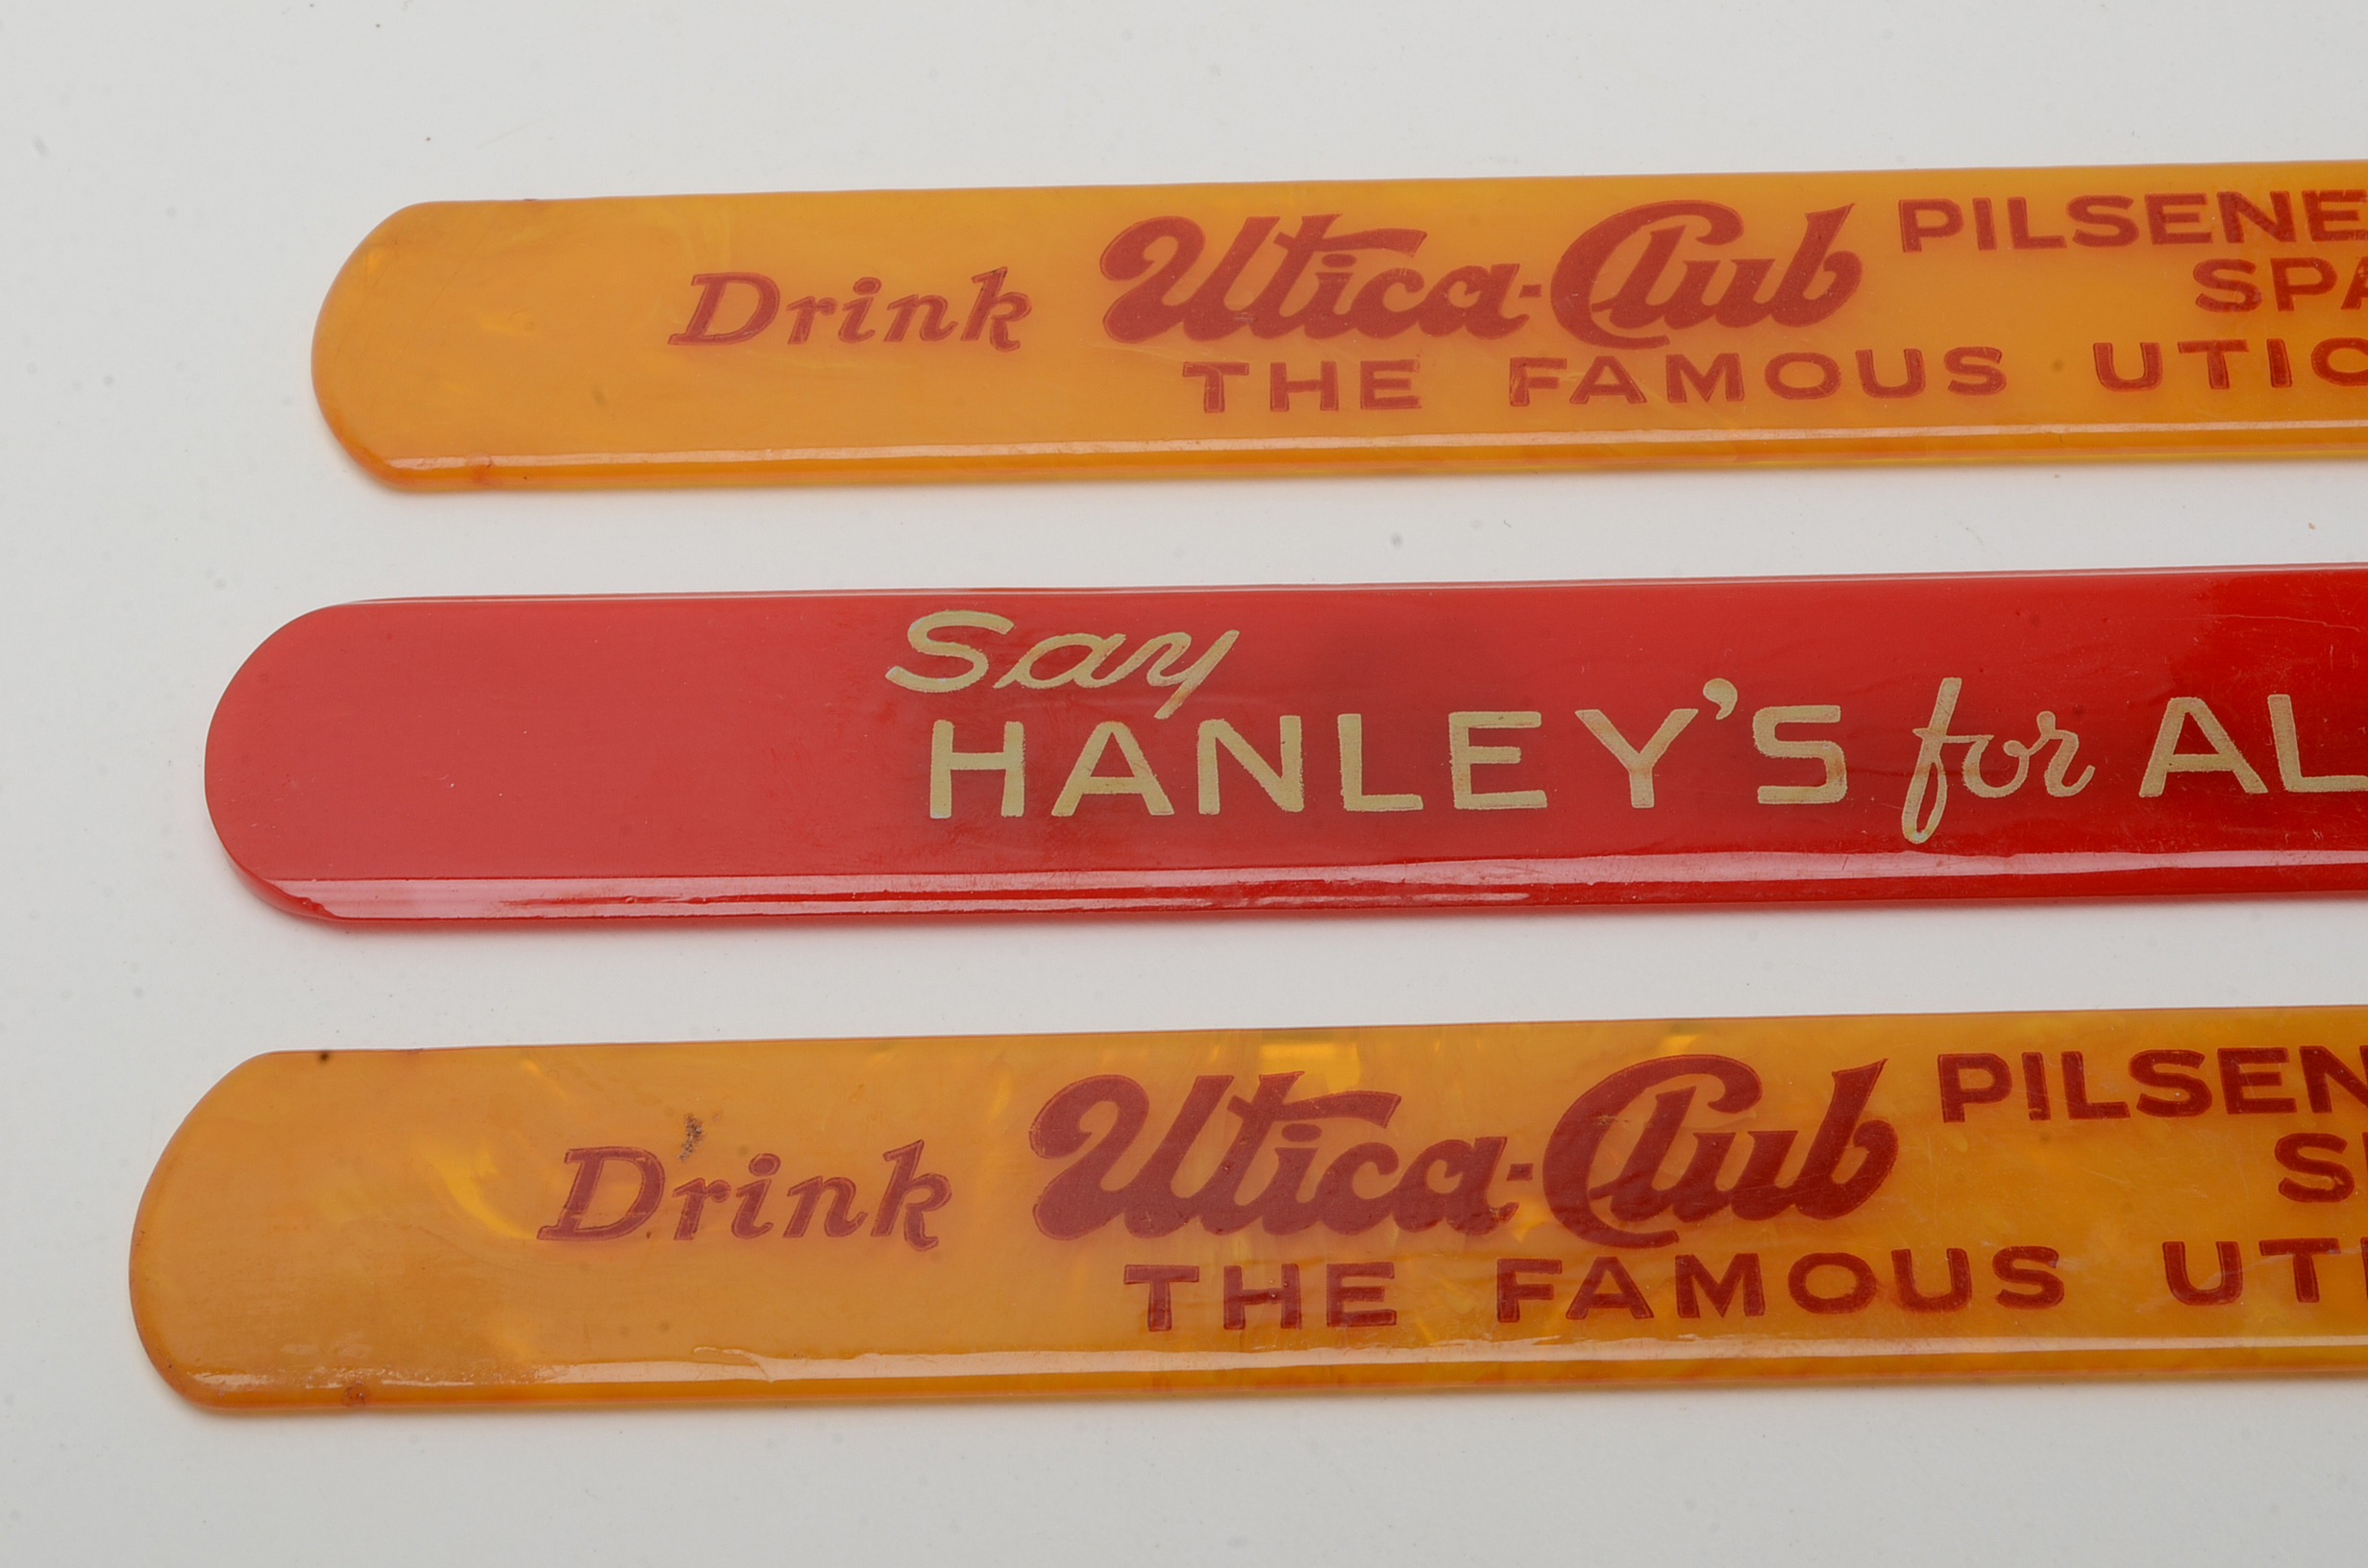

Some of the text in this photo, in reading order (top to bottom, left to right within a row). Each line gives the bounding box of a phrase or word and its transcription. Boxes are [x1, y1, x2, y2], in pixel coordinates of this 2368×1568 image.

[666, 266, 1033, 353] Drink
[1099, 200, 1863, 350] Utica-Club
[1182, 337, 2368, 413] THE FAMOUS UTIC
[885, 609, 1241, 720] Say
[929, 677, 1848, 819] HANLEY'S
[1901, 676, 2096, 844] for
[535, 1139, 952, 1252] Drink
[1028, 1054, 1900, 1250] Utica-Club
[2274, 1131, 2368, 1203] S
[1122, 1262, 1397, 1333] THE
[1495, 1245, 2065, 1323] FAMOUS
